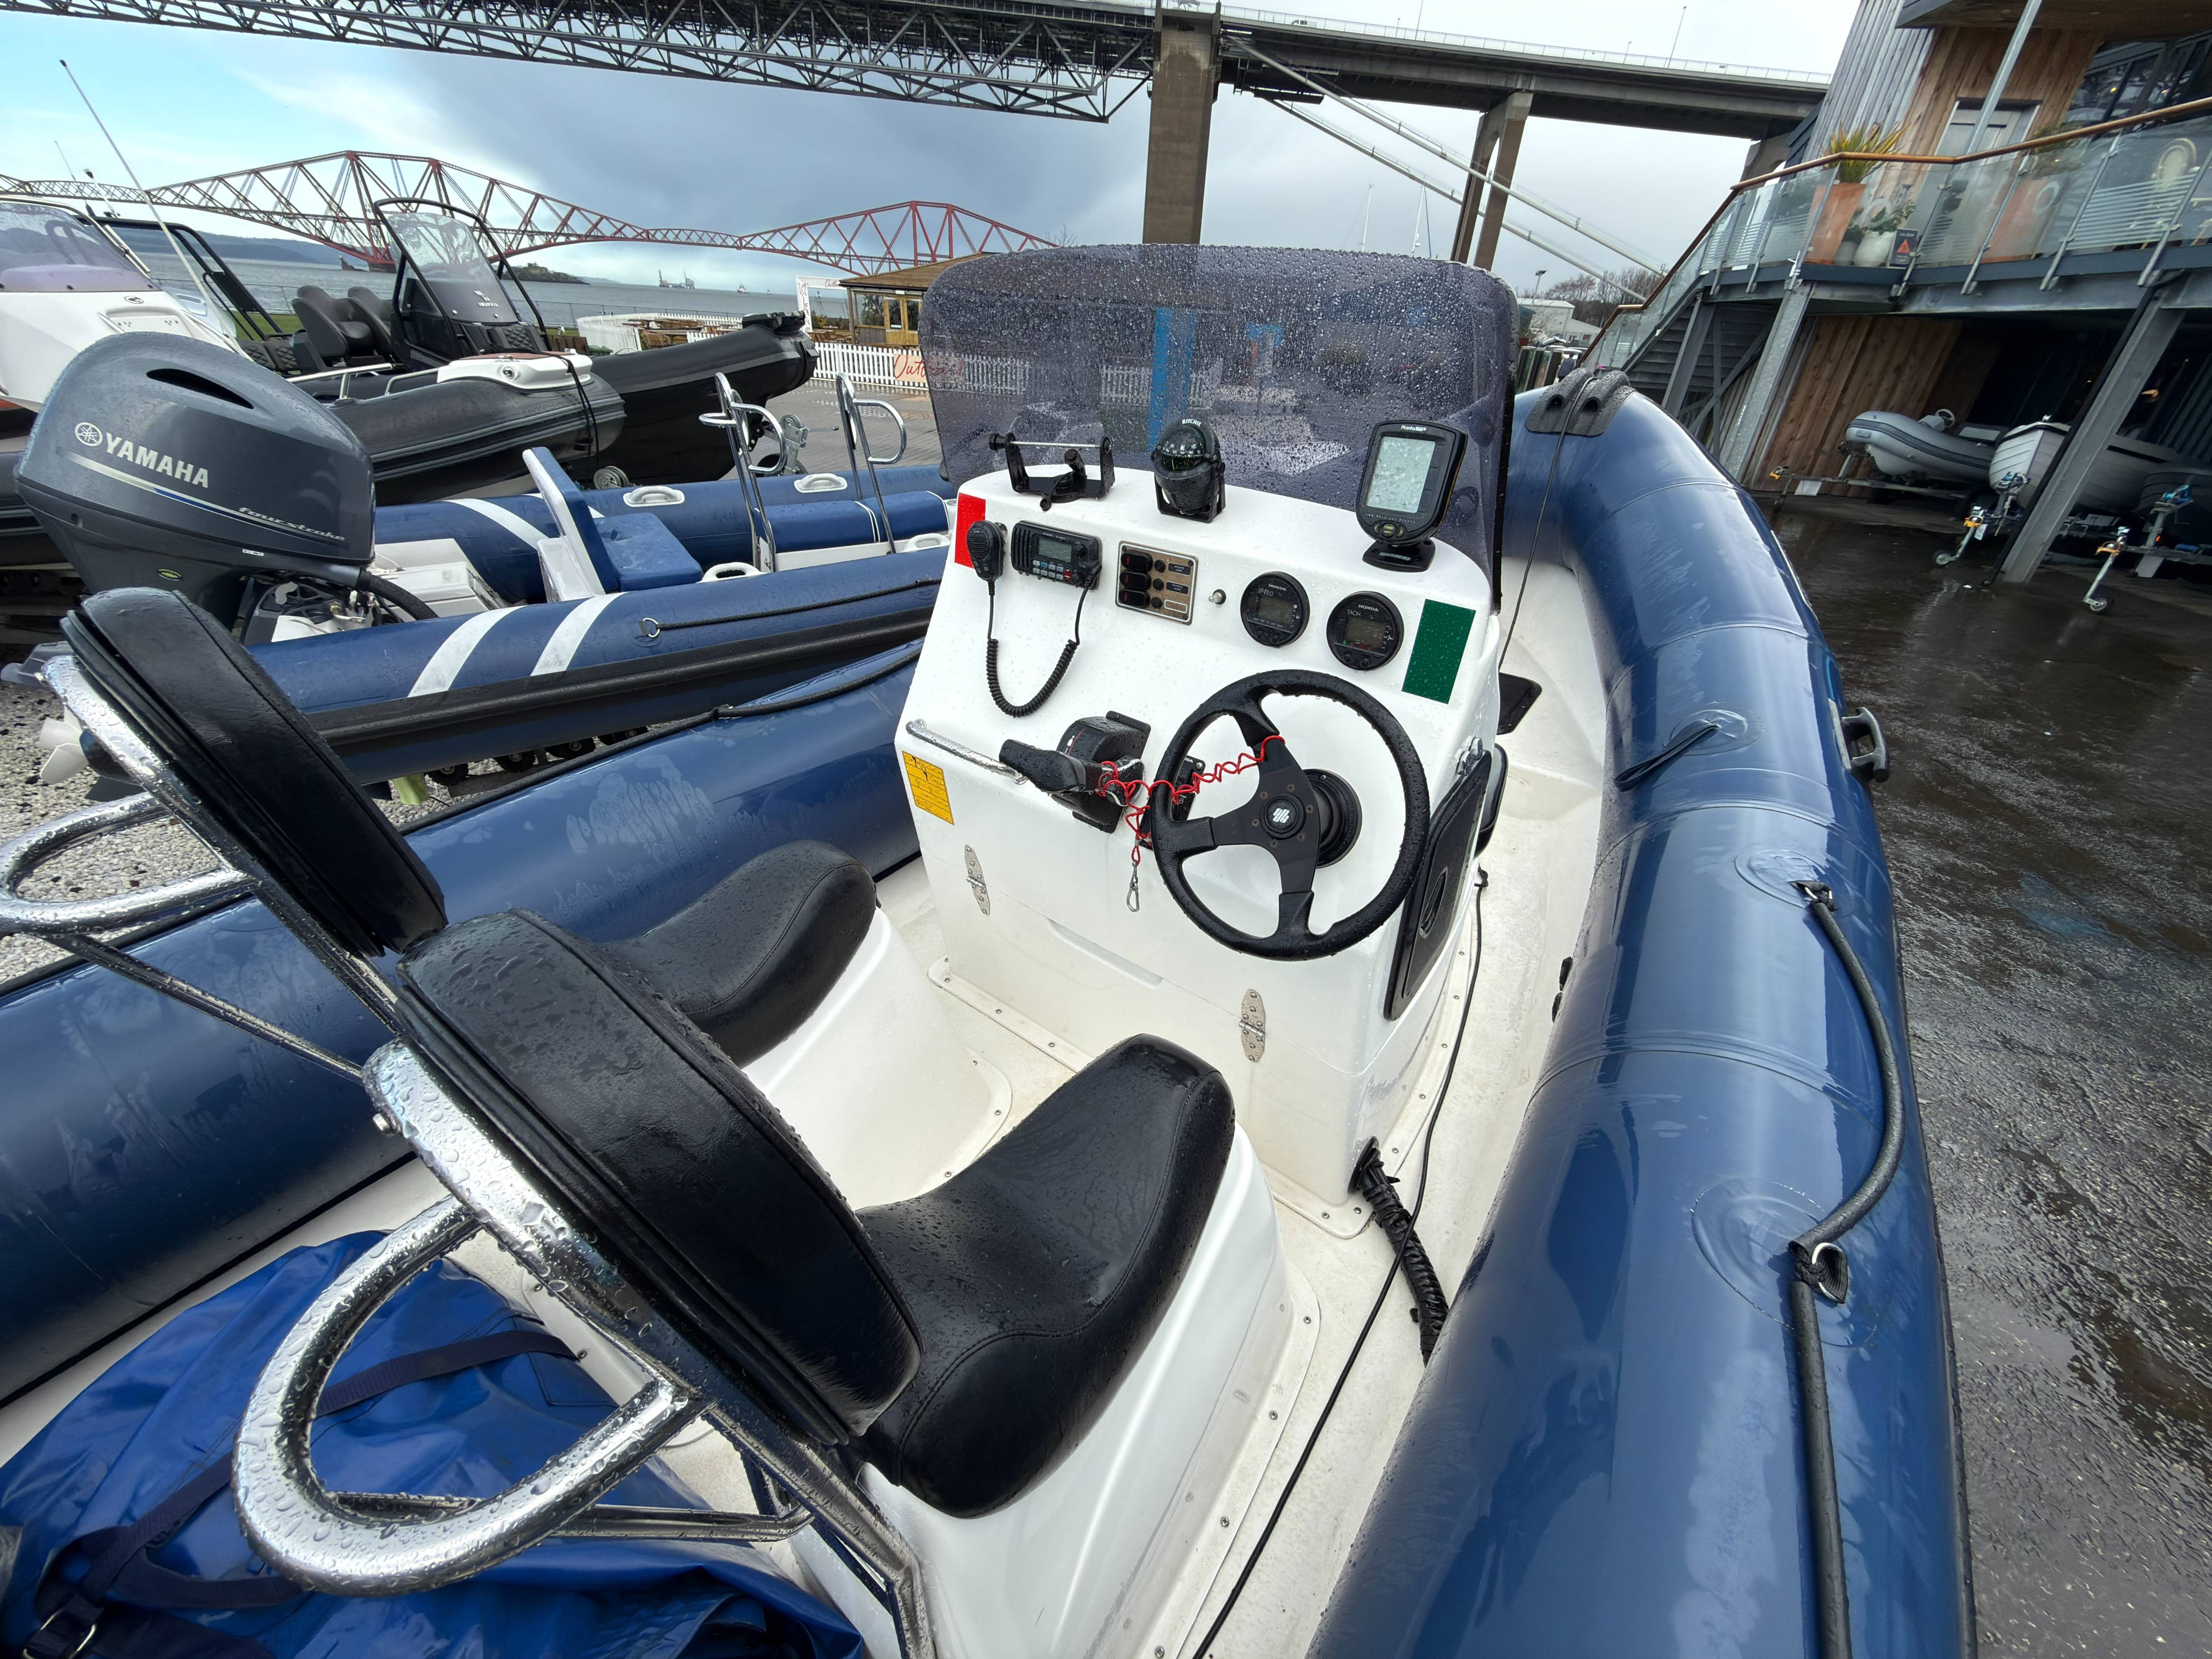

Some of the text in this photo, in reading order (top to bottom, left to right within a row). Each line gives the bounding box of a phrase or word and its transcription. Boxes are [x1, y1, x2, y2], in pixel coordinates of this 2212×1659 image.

[1182, 418, 1202, 427] RITCHIE
[106, 433, 208, 488] YAMAHA
[1379, 552, 1411, 561] HUMMINBIRD
[1258, 588, 1274, 596] SPEED
